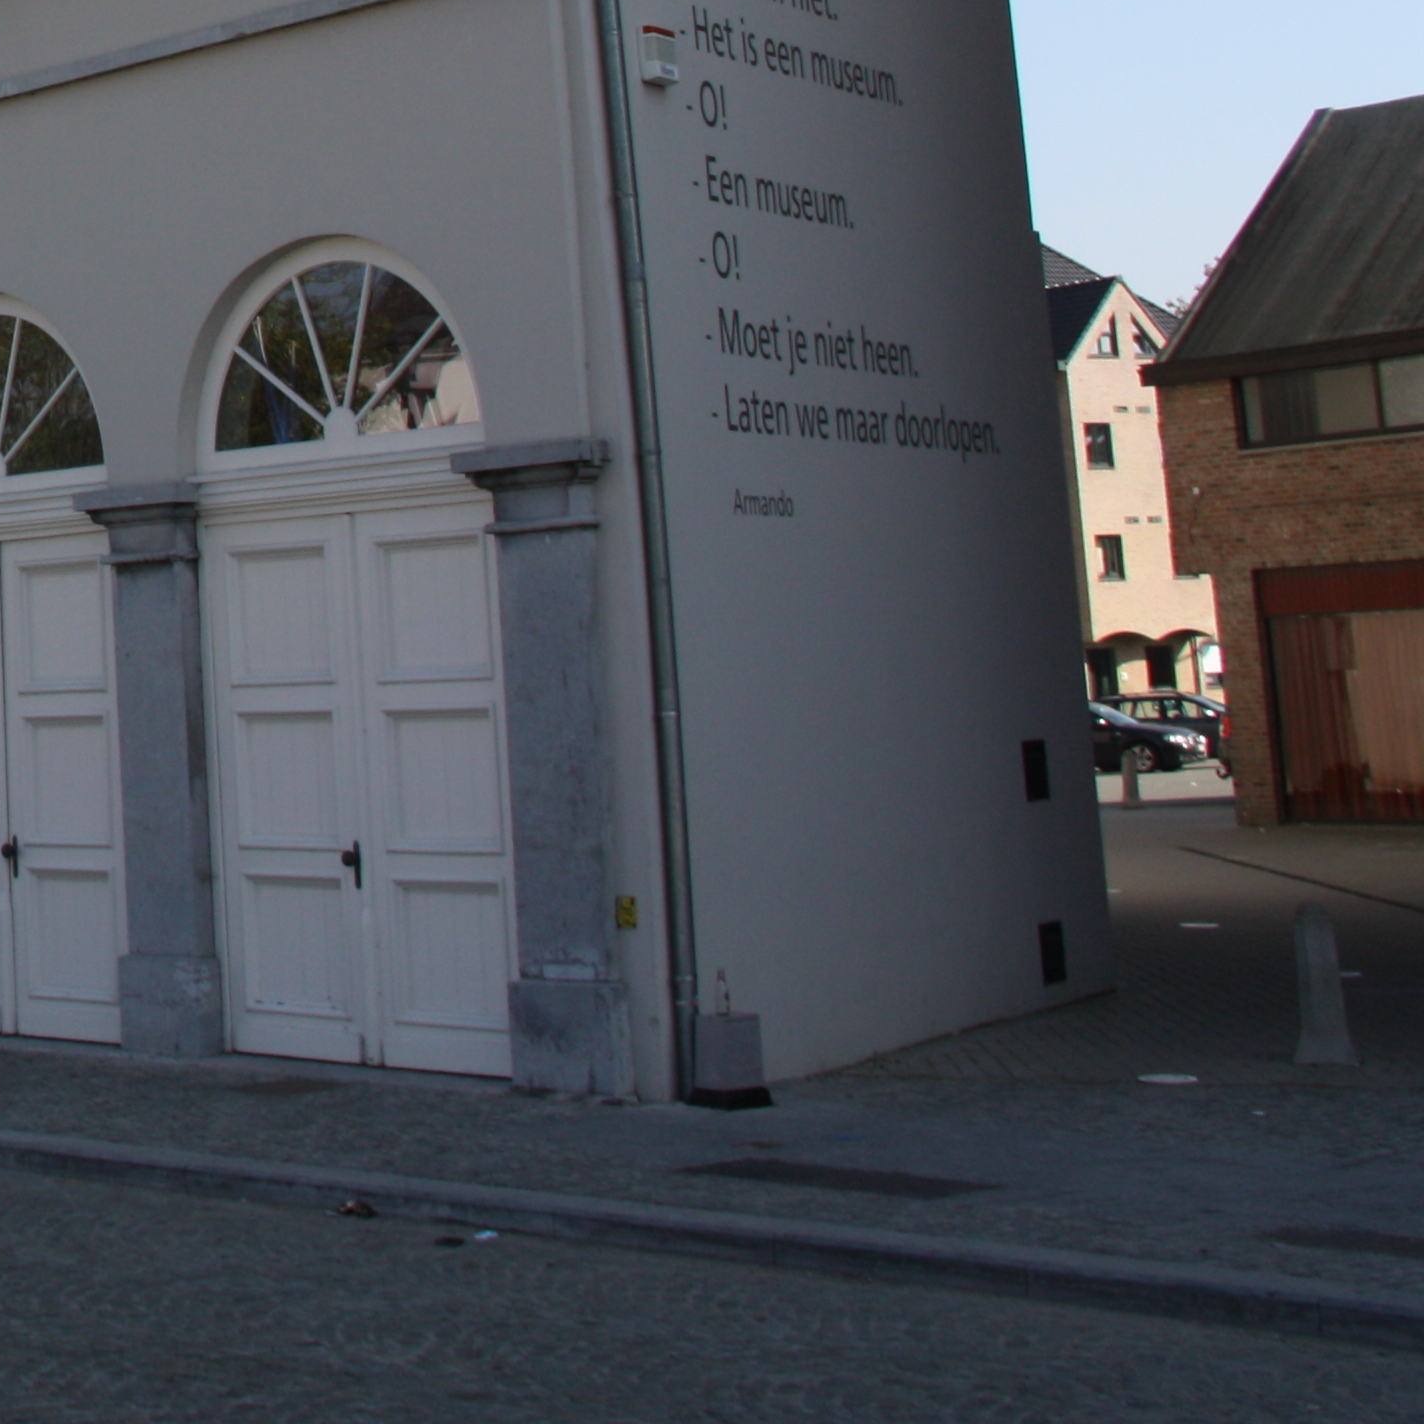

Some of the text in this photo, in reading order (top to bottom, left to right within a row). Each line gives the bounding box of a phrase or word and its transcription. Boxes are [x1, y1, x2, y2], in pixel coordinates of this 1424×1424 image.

[692, 5, 734, 60] Het
[740, 19, 758, 66] is
[765, 39, 803, 78] een
[811, 51, 903, 106] museum.
[700, 81, 727, 130] O!
[705, 155, 748, 208] Een
[756, 174, 854, 229] museum.
[712, 231, 741, 281] O!
[718, 307, 782, 361] Moet
[787, 315, 807, 376] je
[815, 321, 857, 371] niet
[861, 325, 919, 378] heen.
[724, 384, 790, 436] Laten
[795, 405, 829, 439] we
[836, 408, 887, 445] maar
[895, 401, 1000, 464] doorlopen.
[734, 488, 794, 517] Armando
